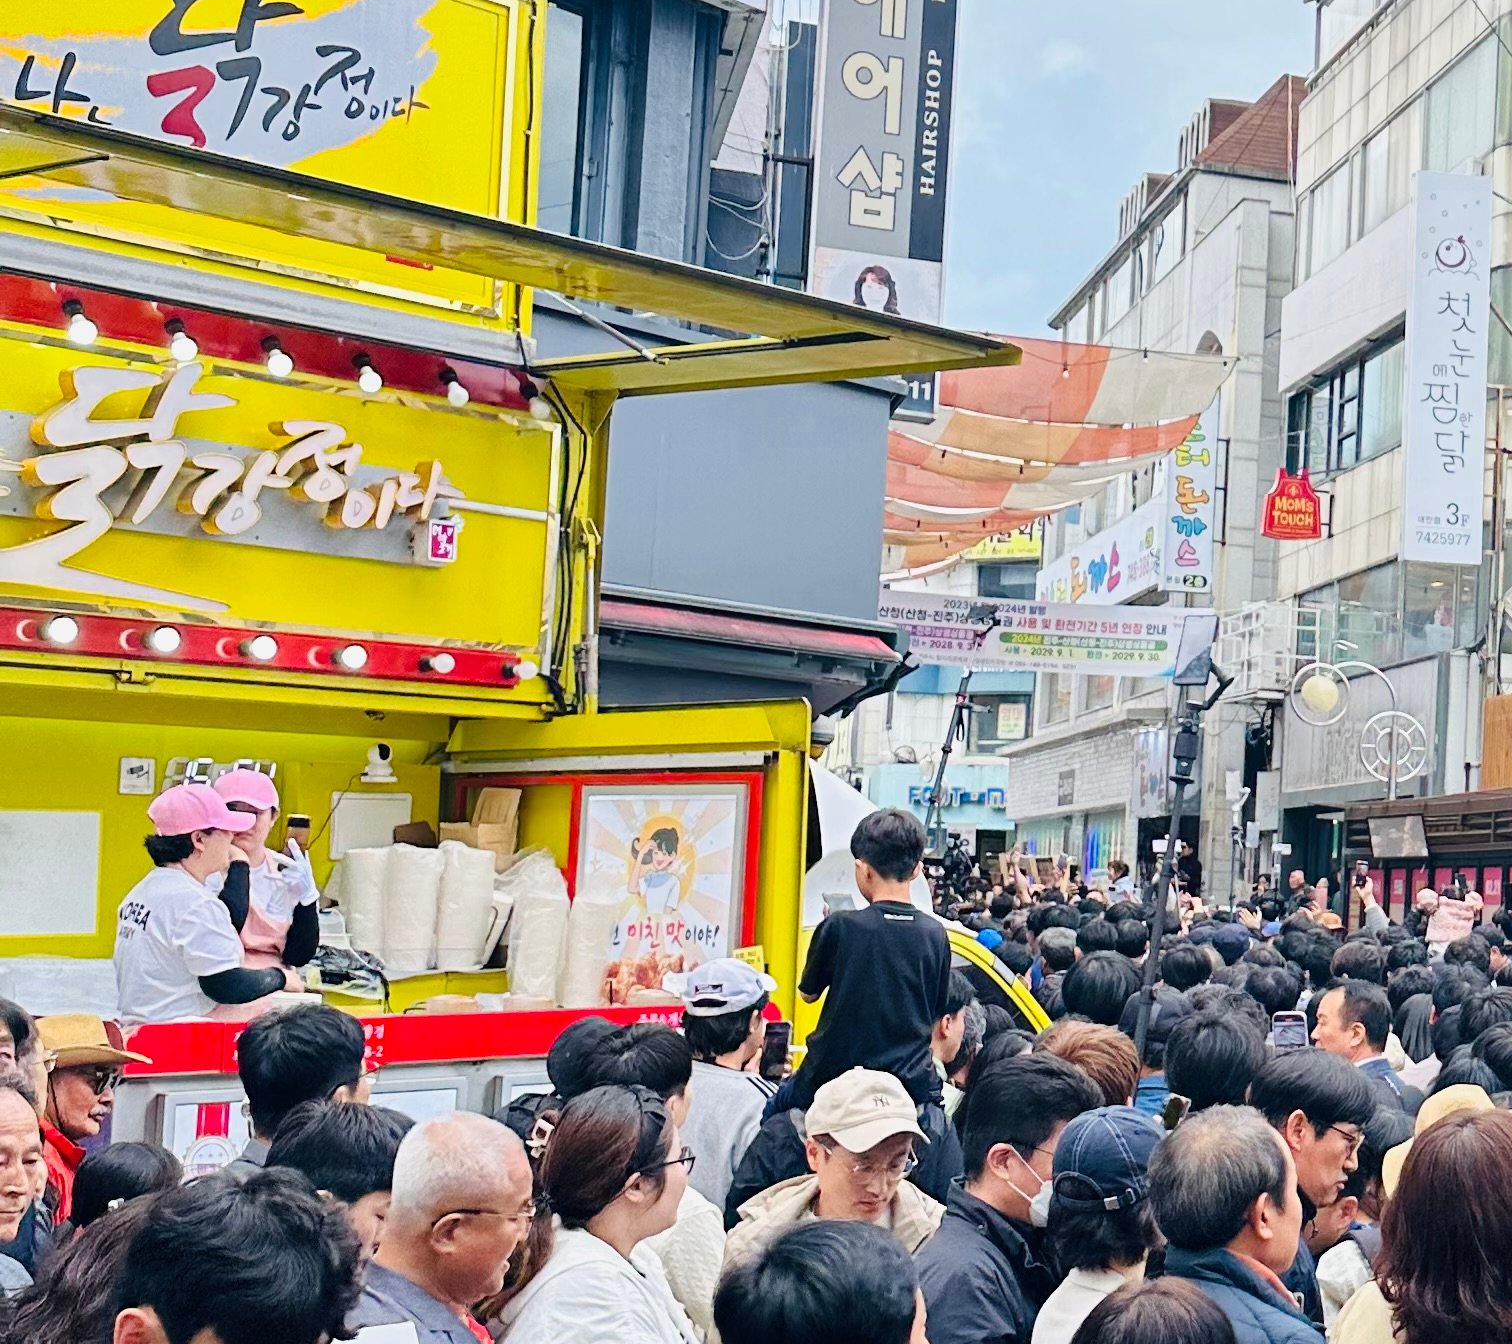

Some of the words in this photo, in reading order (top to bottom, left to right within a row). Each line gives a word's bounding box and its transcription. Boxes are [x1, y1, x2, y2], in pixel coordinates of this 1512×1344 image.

[918, 49, 943, 197] HAIRSHOP
[1172, 475, 1210, 567] 돈까스
[1272, 510, 1313, 527] TOUCH
[1447, 503, 1470, 527] 3F
[1416, 530, 1471, 546] 7425977
[1016, 616, 1038, 630] 사용
[1146, 623, 1167, 636] 안내
[628, 917, 659, 949] 미친
